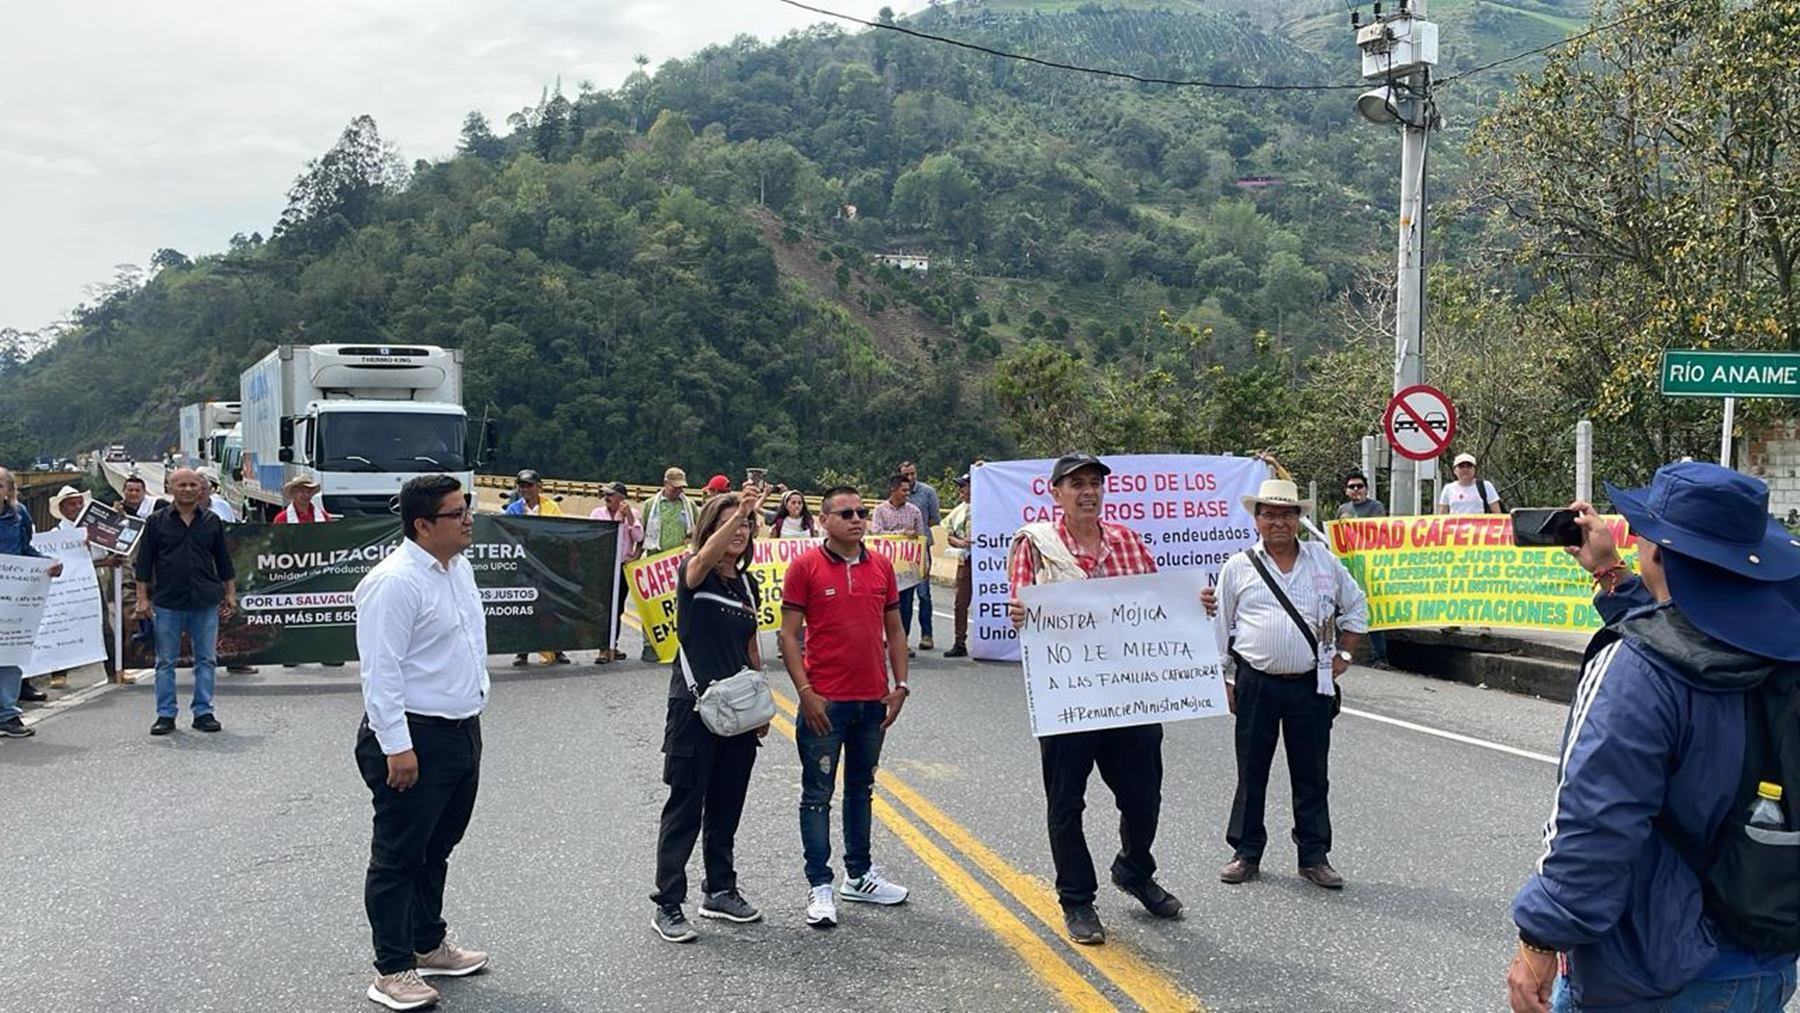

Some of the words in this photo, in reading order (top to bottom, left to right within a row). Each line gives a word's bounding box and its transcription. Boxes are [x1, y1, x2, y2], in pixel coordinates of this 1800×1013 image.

[1670, 361, 1705, 382] RÍO
[1711, 365, 1798, 384] ANAIME
[1155, 474, 1178, 491] DE
[1185, 473, 1217, 490] LOS
[1023, 502, 1145, 522] CAFROS
[1153, 502, 1177, 519] DE
[1184, 501, 1229, 518] BASE
[1162, 526, 1250, 544] endeudados
[1332, 519, 1406, 553] UNIDAD
[1411, 517, 1514, 548] CAFETER
[257, 540, 398, 570] MOVILIZACIÓ
[463, 543, 526, 559] ETERA
[1154, 551, 1229, 567] oluciones
[1373, 553, 1394, 566] UN
[1398, 551, 1454, 566] PRECIO
[1458, 550, 1516, 564] JUSTO
[1521, 551, 1546, 565] DE
[322, 564, 371, 575] Producto
[490, 562, 518, 571] UPCC
[1371, 568, 1386, 581] LA
[1389, 566, 1447, 580] DEFENSA
[1450, 564, 1470, 578] DE
[1473, 564, 1500, 578] LAS
[1371, 582, 1381, 596] LA
[1385, 581, 1431, 595] DEFENSA
[1434, 580, 1449, 593] DE
[1451, 580, 1464, 593] LA
[246, 597, 273, 607] POR
[276, 597, 293, 607] LA
[295, 594, 354, 605] SALVACI
[494, 590, 535, 600] JUSTOS
[247, 614, 283, 625] PARA
[285, 610, 313, 624] MÁS
[316, 612, 332, 623] DE
[1025, 605, 1097, 633] MINISTRA
[1386, 600, 1412, 623] LAS
[1417, 598, 1568, 625] IMPORTACIONES
[1047, 642, 1072, 664] NO
[1084, 644, 1109, 662] LE
[1123, 641, 1194, 661] MIENTA
[1049, 676, 1060, 690] A
[1068, 675, 1093, 690] LAS
[1096, 671, 1159, 687] FAMILIAS
